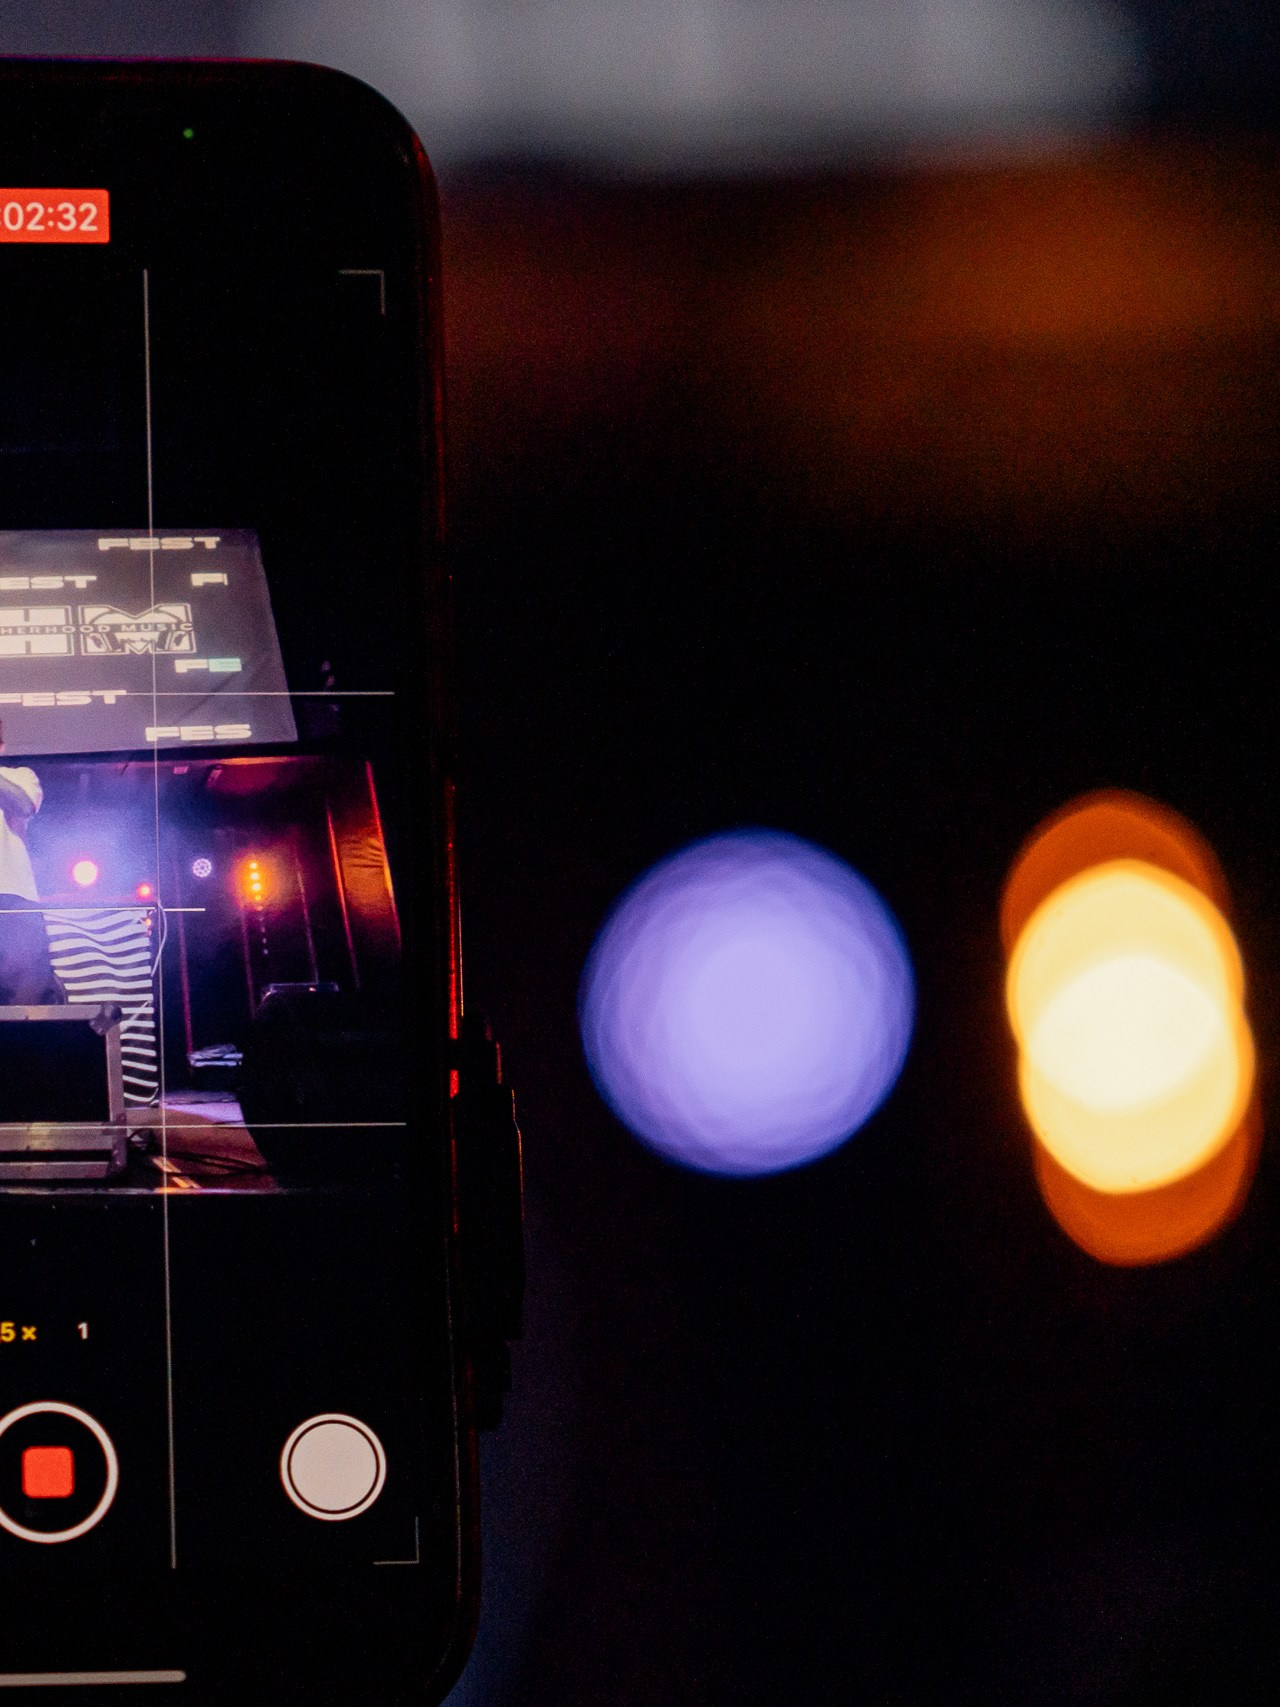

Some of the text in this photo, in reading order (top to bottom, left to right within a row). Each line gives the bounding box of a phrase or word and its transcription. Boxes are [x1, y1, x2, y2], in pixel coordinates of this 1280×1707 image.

[98, 536, 221, 551] FEST
[121, 622, 194, 633] MUSIC
[77, 1321, 89, 1340] 1
